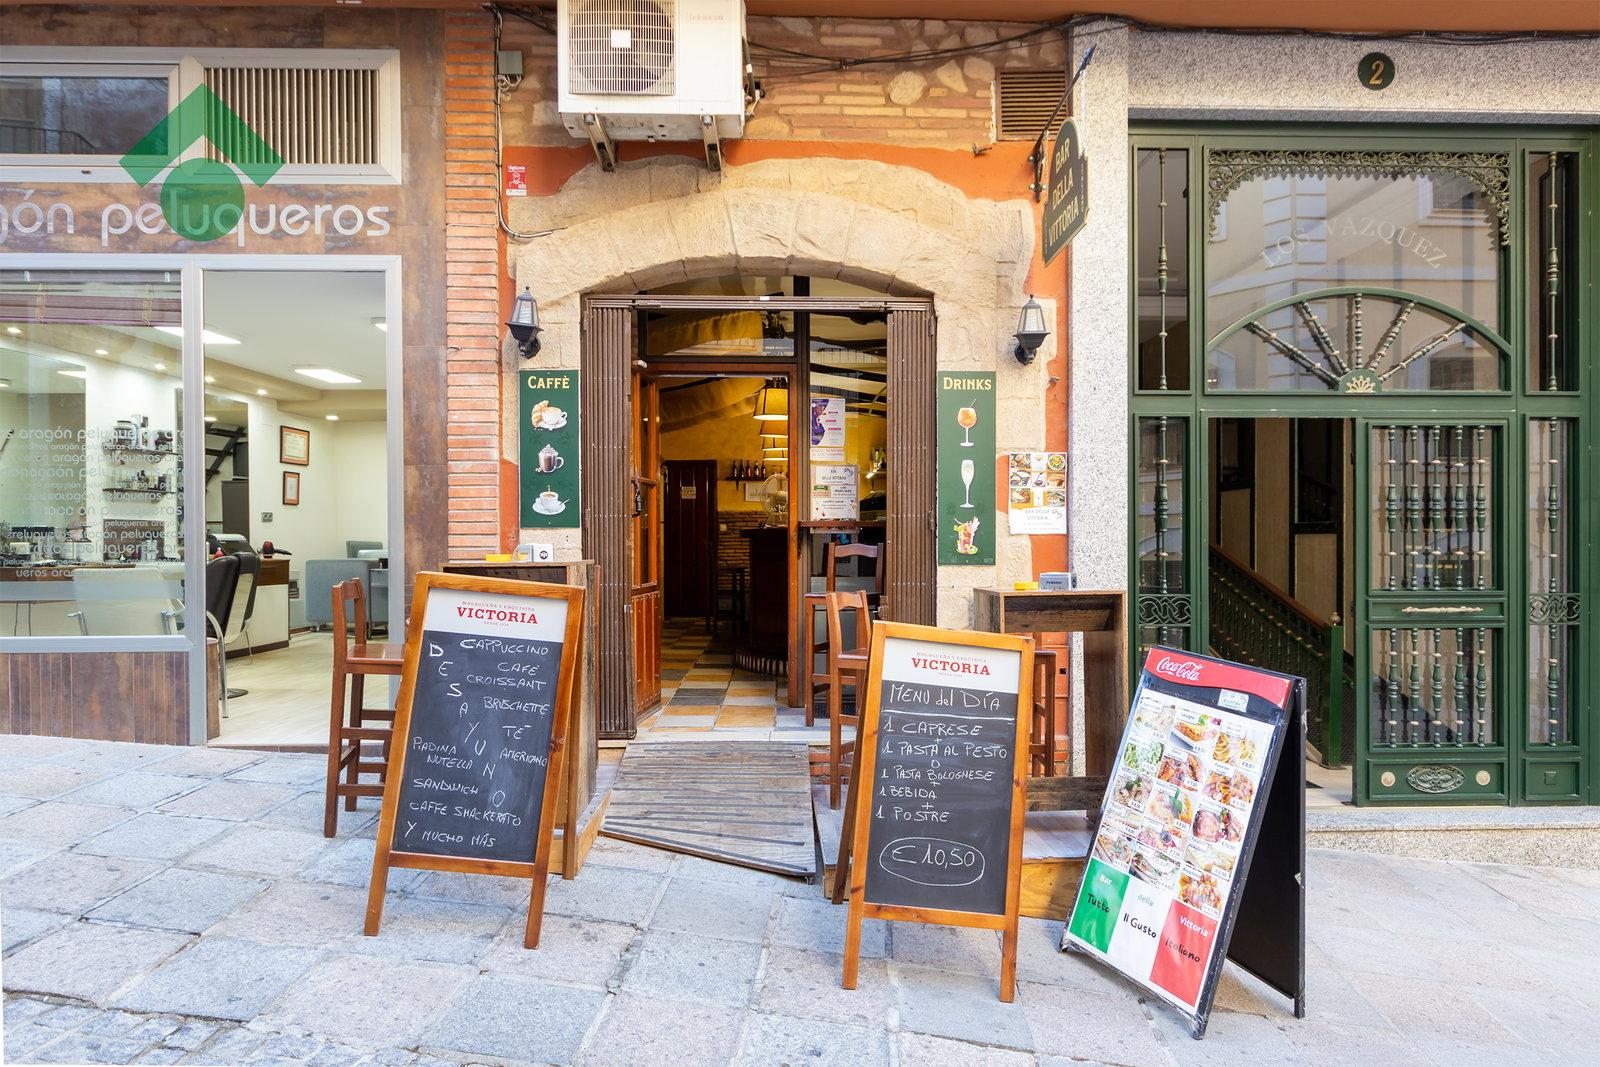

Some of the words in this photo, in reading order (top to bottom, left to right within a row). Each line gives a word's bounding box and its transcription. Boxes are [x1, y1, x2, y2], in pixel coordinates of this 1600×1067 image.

[1370, 60, 1385, 84] 2
[1055, 138, 1070, 174] BAR
[1052, 168, 1074, 210] DELLA
[101, 188, 391, 247] peluqueros
[1048, 195, 1079, 247] VITTORIA
[1259, 227, 1310, 269] LOS
[527, 374, 570, 389] CAFFÈ
[19, 425, 72, 442] aragón
[50, 442, 79, 452] aragón
[52, 451, 95, 465] aragón
[105, 519, 149, 530] peluqueros
[457, 606, 538, 624] VICTORIA
[460, 638, 549, 655] CAPPUCCINO
[911, 657, 991, 676] VICTORIA
[466, 674, 546, 691] CROISSANT
[889, 683, 930, 704] MENU
[960, 690, 1001, 711] DÍA
[883, 716, 894, 732] 1
[901, 721, 983, 737] CAPRESE
[412, 736, 457, 755] PIADINA
[882, 741, 893, 754] 1
[898, 741, 939, 757] PASTA
[943, 746, 959, 756] AL
[963, 742, 1008, 758] PESTO
[426, 754, 473, 770] NUTELLA
[880, 768, 890, 779] 1
[893, 765, 922, 780] PASTA
[926, 769, 996, 781] BOLOGNESE
[413, 778, 479, 795] SANDWICH
[879, 786, 887, 796] 1
[889, 785, 938, 799] BEBIDA
[409, 800, 448, 815] CAFFE
[453, 806, 522, 826] SHACKERATO
[875, 804, 885, 818] 1
[893, 806, 950, 822] POSTRE
[405, 820, 417, 838] Y
[422, 829, 463, 843] MUCHO
[471, 833, 496, 847] MÁS
[1100, 874, 1113, 886] Bar
[1137, 894, 1154, 907] della
[1179, 915, 1209, 938] Vittoria
[1087, 893, 1111, 914] Tutto
[1130, 917, 1157, 939] Gusto
